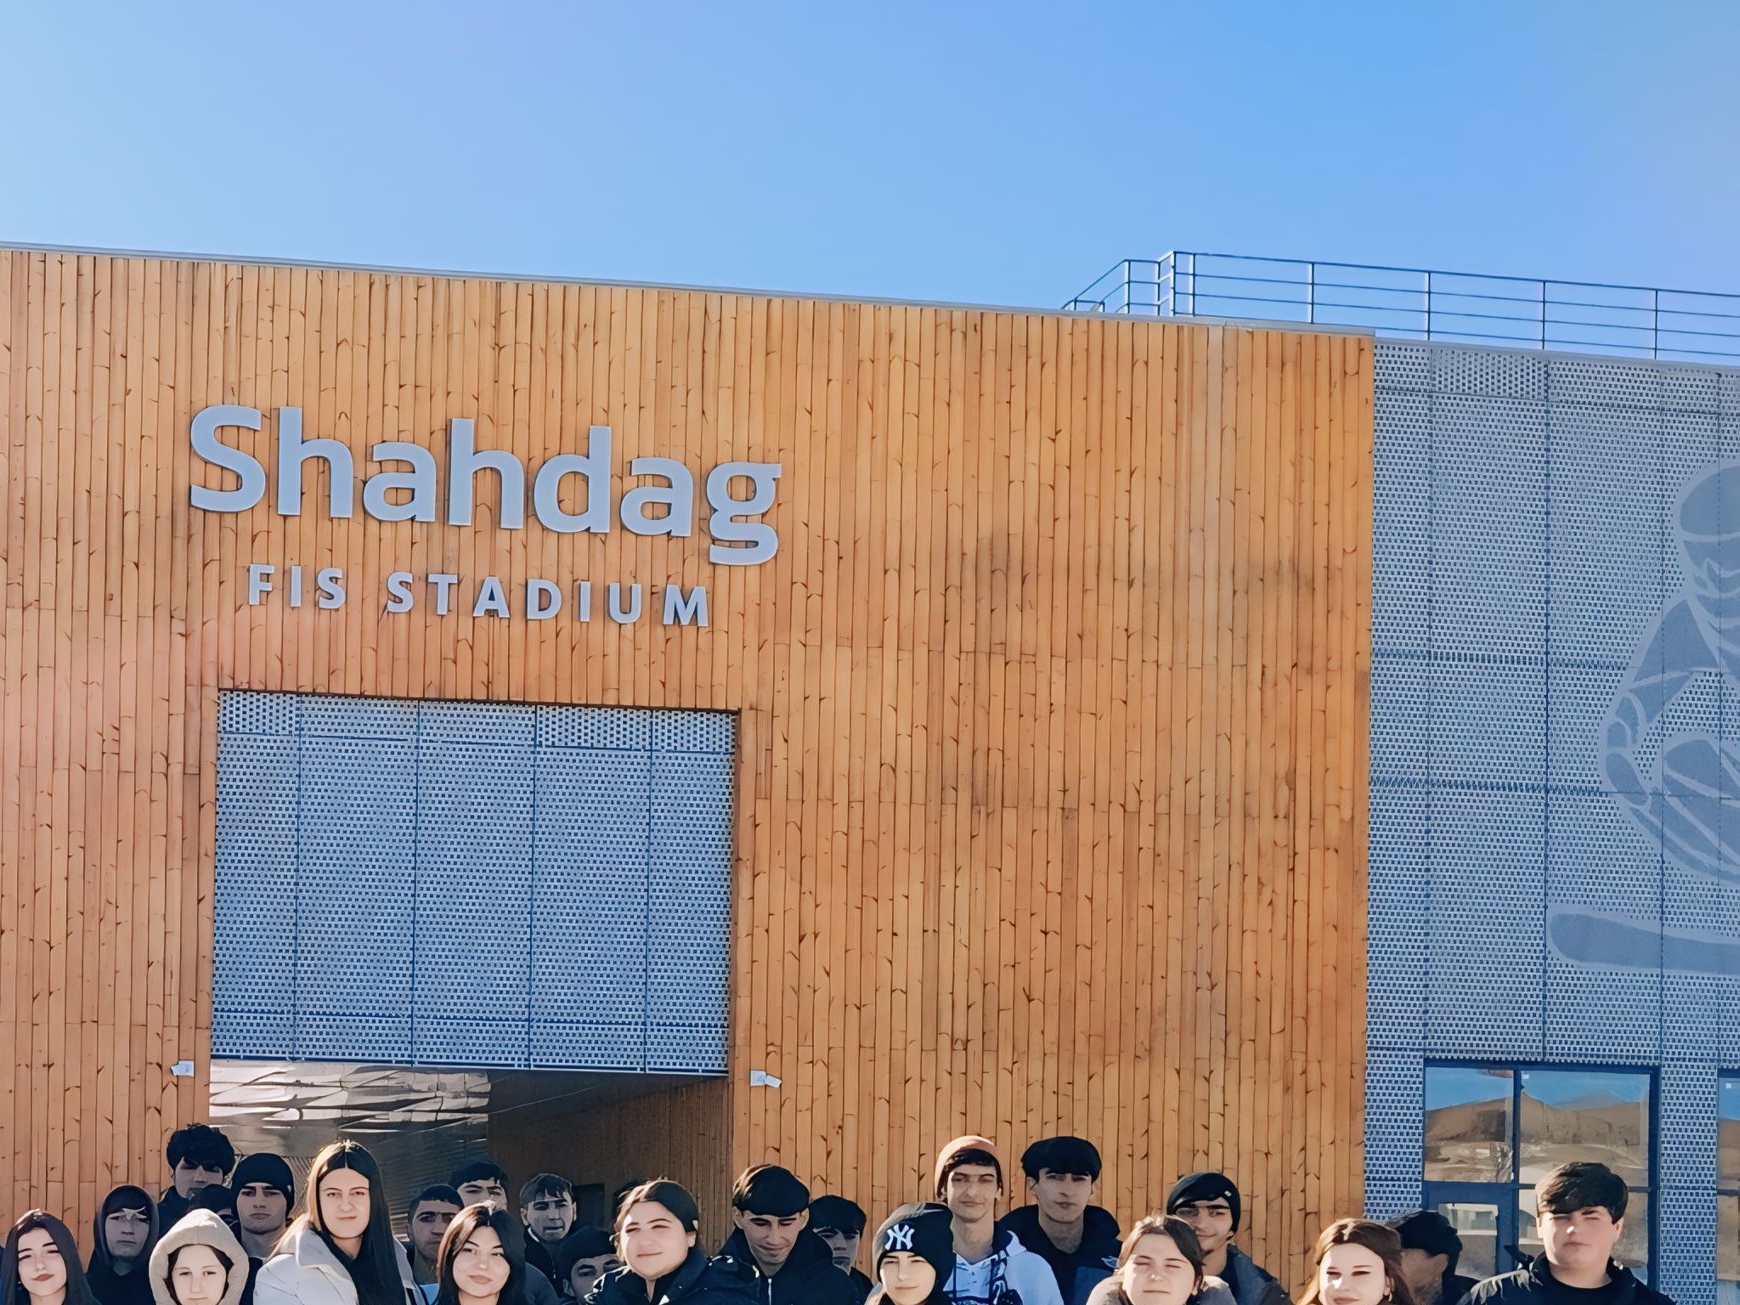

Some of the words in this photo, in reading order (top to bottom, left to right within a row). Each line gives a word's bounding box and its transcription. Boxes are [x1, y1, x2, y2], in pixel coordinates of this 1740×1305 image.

[190, 404, 781, 566] Shahdag
[248, 563, 346, 609] FIS
[387, 571, 708, 627] STADIUM
[885, 1223, 915, 1251] NY
